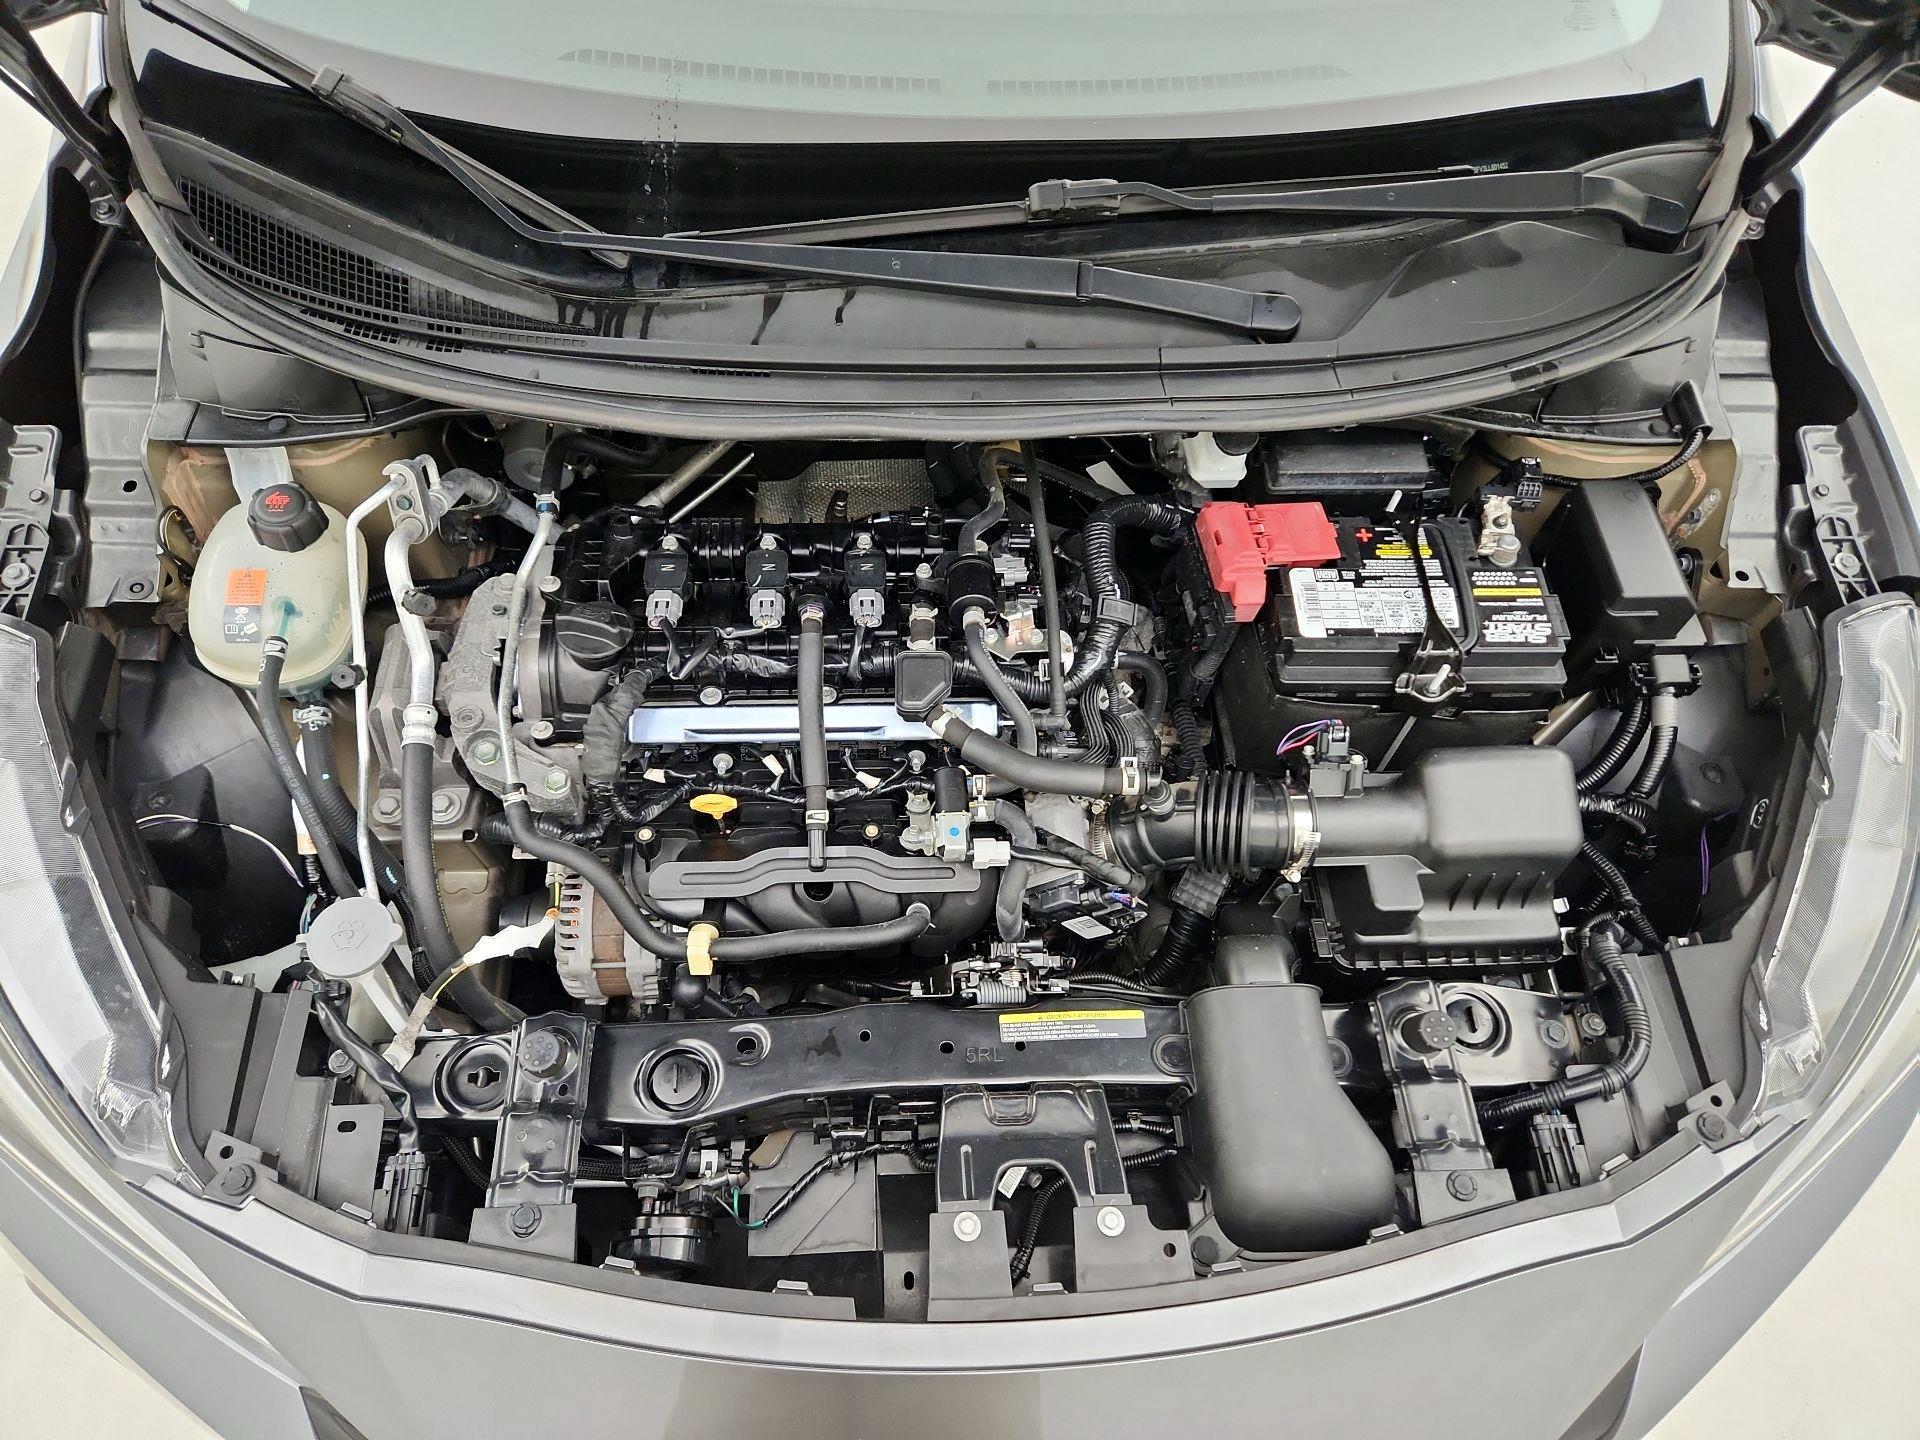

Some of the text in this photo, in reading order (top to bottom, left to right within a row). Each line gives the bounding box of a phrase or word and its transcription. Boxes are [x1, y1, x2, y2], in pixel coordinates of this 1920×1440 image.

[1484, 622, 1552, 636] START
[1485, 632, 1548, 644] SUPER
[966, 1047, 1004, 1064] 5RL
